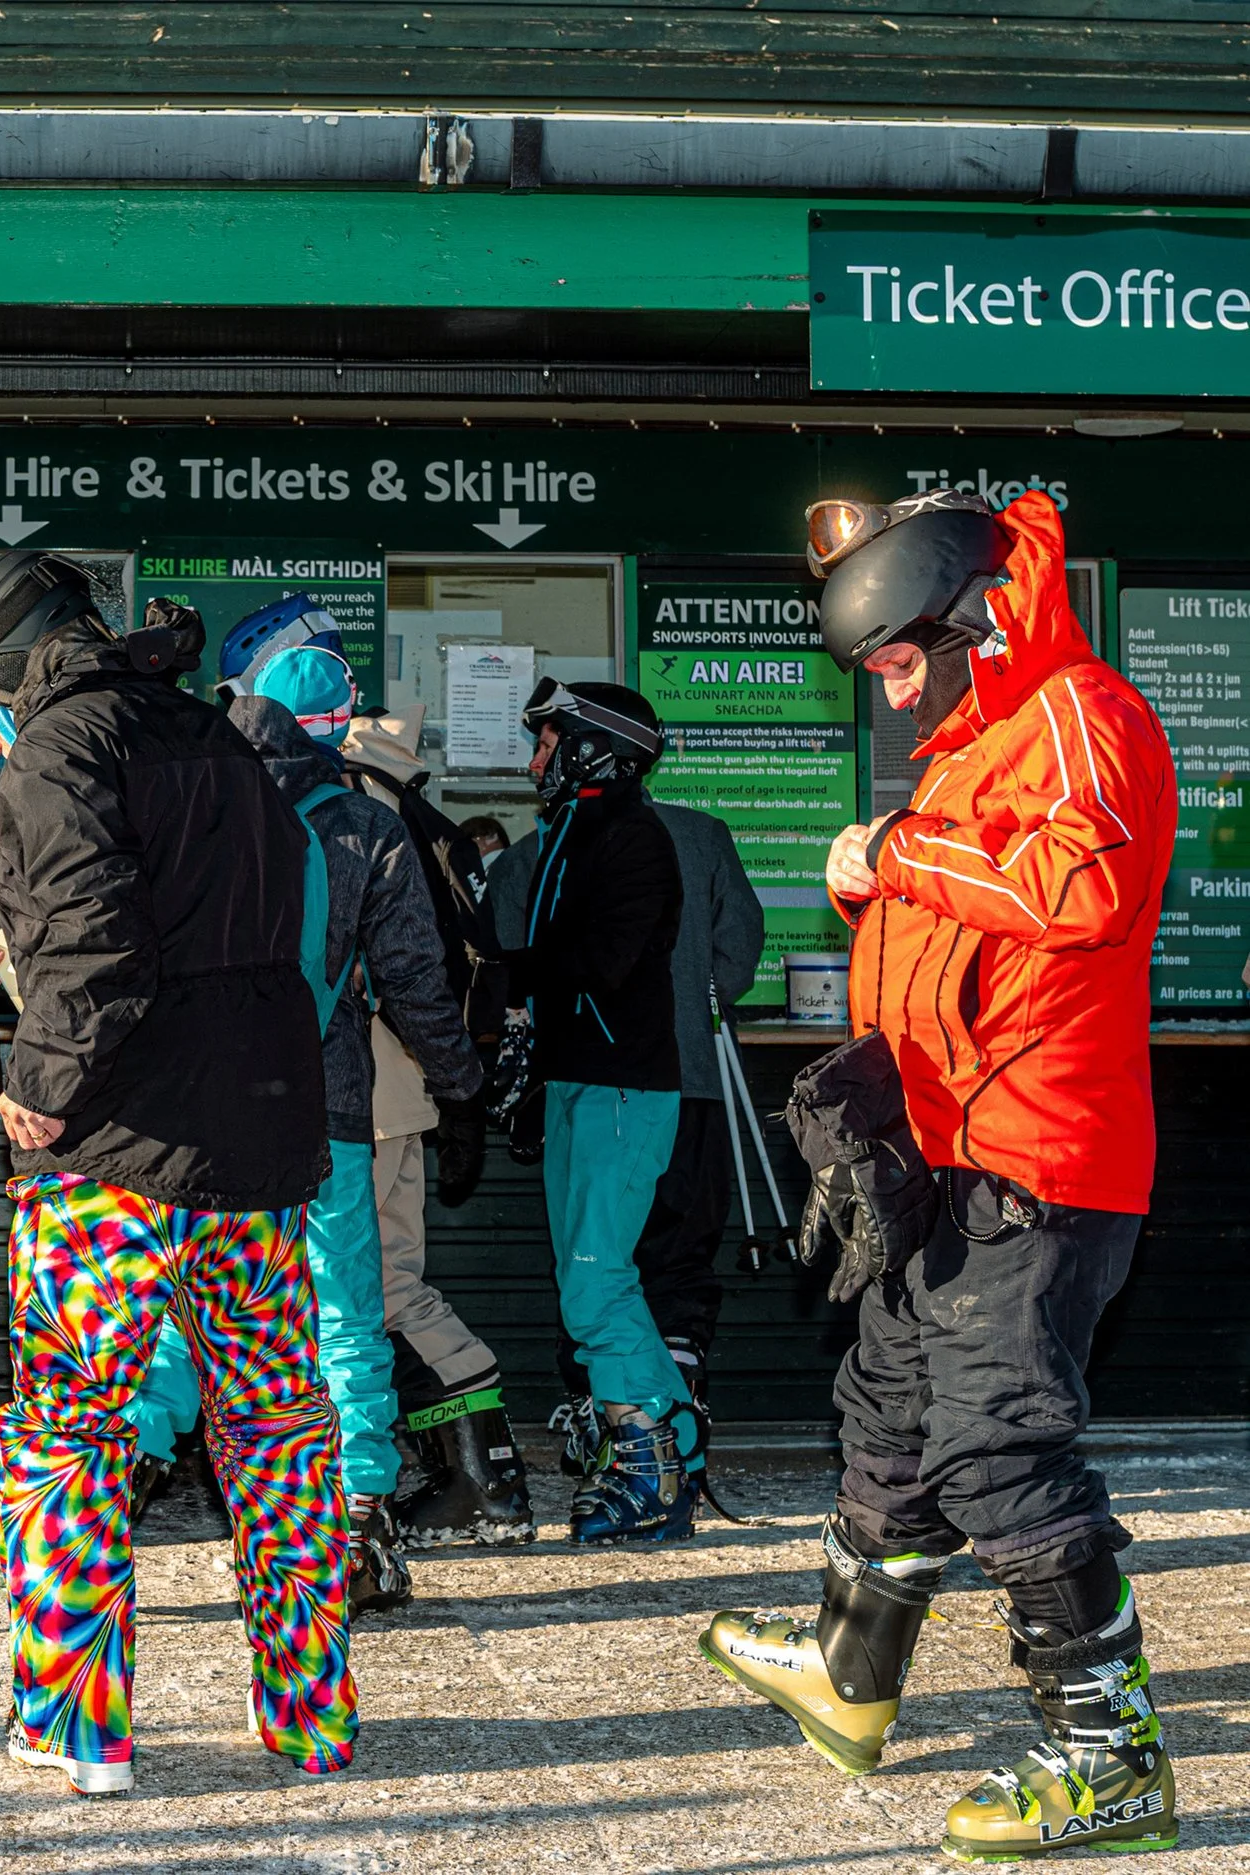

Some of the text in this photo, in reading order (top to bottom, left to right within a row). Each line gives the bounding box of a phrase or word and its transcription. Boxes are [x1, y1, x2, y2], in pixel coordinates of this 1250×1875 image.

[846, 265, 1250, 330] Ticket Office
[5, 456, 100, 498] Hire
[126, 457, 167, 499] &
[179, 457, 350, 501] Tickets
[366, 459, 407, 503] &
[424, 459, 492, 503] Ski
[502, 461, 596, 503] Hire
[142, 555, 382, 579] SKI HIRE MÀL SGITHIDH
[321, 592, 375, 605] you reach
[326, 606, 375, 617] have the
[655, 598, 821, 625] ATTENTION
[1168, 597, 1250, 618] Lift Tick
[652, 631, 747, 644] SNOWSPORTS
[749, 632, 807, 645] INVOLVE
[1128, 628, 1155, 640] Adult
[1128, 657, 1169, 669] Student
[690, 660, 805, 685] AN AIRE!
[1128, 671, 1162, 686] Family
[1179, 672, 1193, 684] ad
[1224, 673, 1241, 687] jun
[655, 690, 682, 701] THA
[684, 690, 745, 701] CUNNART
[749, 690, 776, 701] ANN
[779, 690, 797, 701] AN
[1141, 687, 1162, 701] mily
[1179, 687, 1193, 698] ad
[1224, 688, 1241, 701] jun
[714, 704, 784, 716] SNEACHDA
[1158, 702, 1204, 714] beginner
[686, 729, 703, 738] you
[722, 728, 752, 738] accept
[754, 728, 769, 736] the
[771, 728, 793, 736] risks
[794, 728, 833, 737] involved
[835, 728, 844, 736] in
[686, 738, 711, 749] sport
[712, 738, 742, 747] before
[744, 738, 776, 750] buying
[785, 739, 799, 748] lift
[800, 739, 826, 748] ticket
[1182, 745, 1205, 756] with
[1207, 746, 1214, 756] 4
[1216, 746, 1250, 758] uplifts
[678, 756, 723, 764] cinnteach
[724, 757, 742, 766] gun
[744, 756, 768, 767] gabh
[769, 756, 785, 765] thu
[795, 757, 843, 765] cunnartan
[1182, 759, 1220, 771] with no
[718, 766, 765, 775] ceannaich
[767, 766, 782, 776] thu
[716, 785, 744, 797] proof
[745, 785, 756, 795] of
[757, 787, 774, 797] age
[776, 786, 784, 795] is
[786, 785, 827, 797] required
[1179, 787, 1243, 807] tificial
[717, 799, 753, 808] feumar
[754, 799, 806, 809] dearbhadh
[808, 800, 821, 809] air
[728, 823, 809, 832] matriculation card
[753, 858, 786, 867] tickets
[788, 871, 801, 879] air
[1190, 876, 1250, 898] Parkin
[1160, 912, 1190, 921] ervan
[764, 931, 839, 942] fore leaving the
[1192, 924, 1242, 939] Overnight
[777, 942, 832, 952] be rectified
[1160, 987, 1243, 1002] All prices are a
[635, 1513, 668, 1528] HEAD
[1040, 1789, 1165, 1845] LANGE
